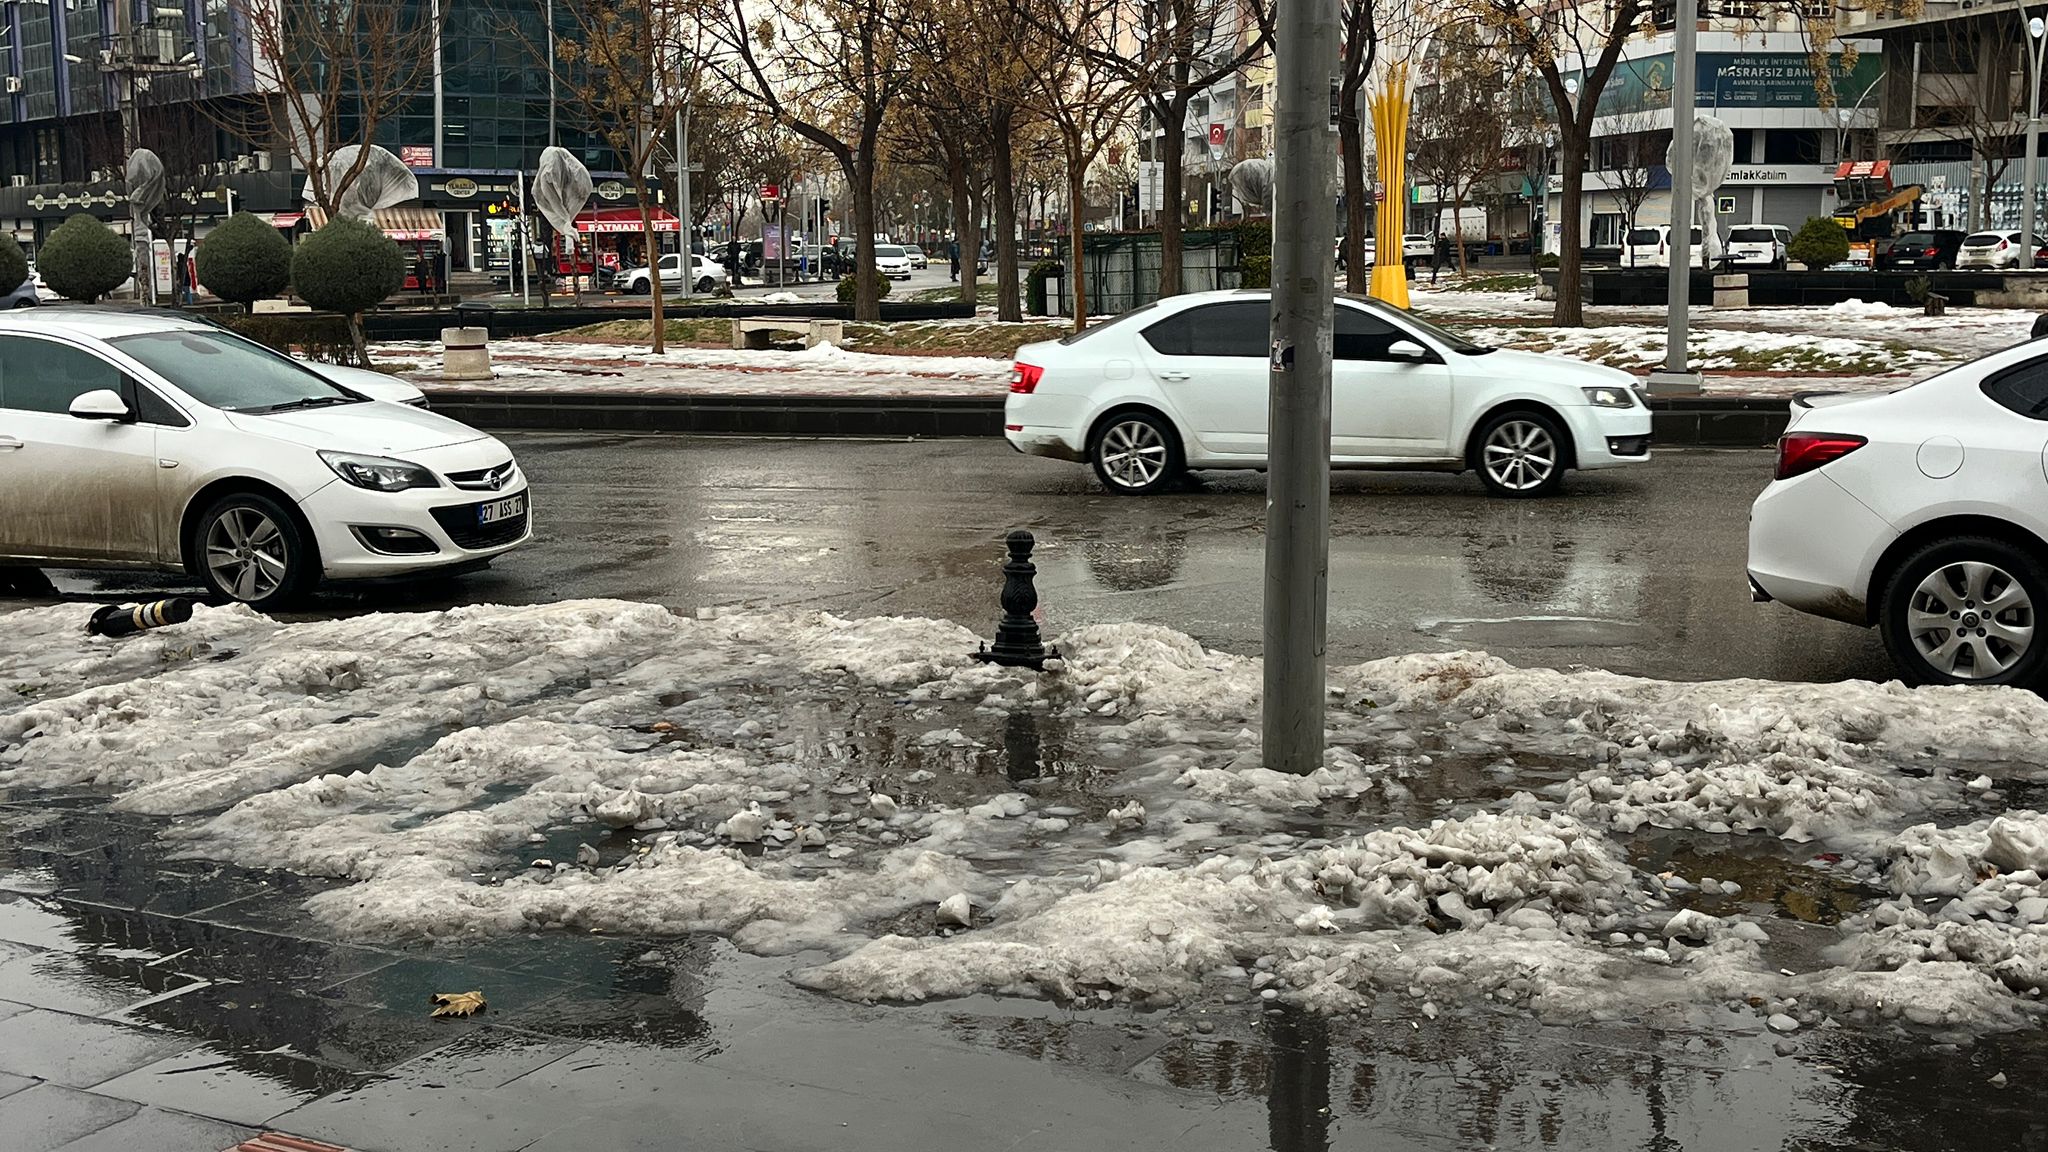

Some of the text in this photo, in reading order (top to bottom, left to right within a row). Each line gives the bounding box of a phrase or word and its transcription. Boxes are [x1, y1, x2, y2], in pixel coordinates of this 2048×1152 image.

[1717, 66, 1783, 77] MASRAFSIZ
[588, 223, 642, 232] BATMAN
[483, 505, 494, 521] 27
[500, 500, 512, 518] ASS
